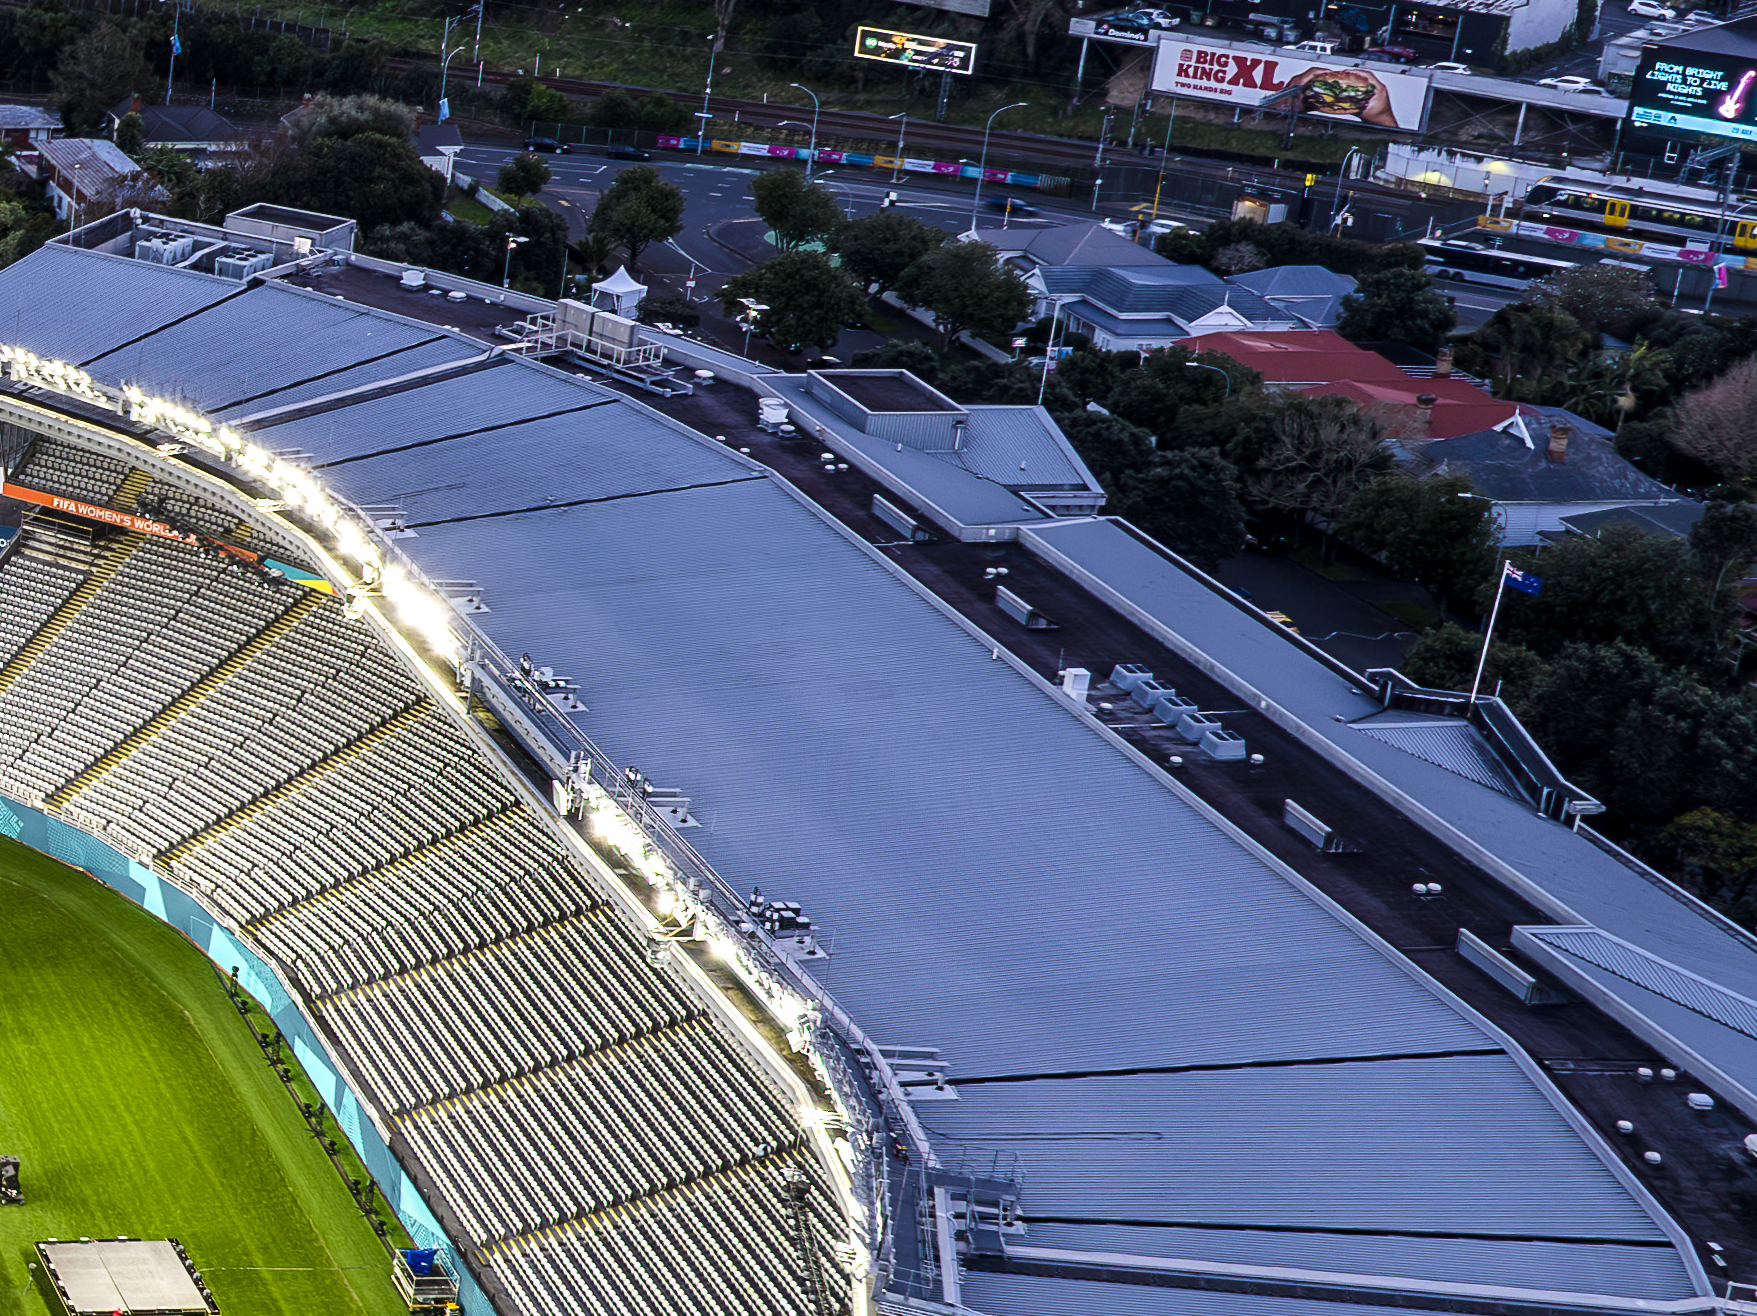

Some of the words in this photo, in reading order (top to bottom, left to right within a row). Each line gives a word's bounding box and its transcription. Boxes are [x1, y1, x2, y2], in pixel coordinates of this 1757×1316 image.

[1107, 28, 1145, 41] Domino's
[1195, 49, 1230, 68] BIG
[1176, 63, 1227, 83] KING
[1227, 55, 1285, 91] XL
[1645, 70, 1683, 83] LIGHTS
[1687, 76, 1700, 86] TO
[1702, 80, 1729, 91] LIVE
[1654, 62, 1684, 74] FROM
[1685, 66, 1724, 80] BRIGHT
[1174, 81, 1192, 89] TWO
[1193, 84, 1218, 94] HANDS
[1666, 83, 1703, 96] NIGHTS
[53, 497, 75, 513] FIFA
[77, 502, 132, 527] WOMEN'S
